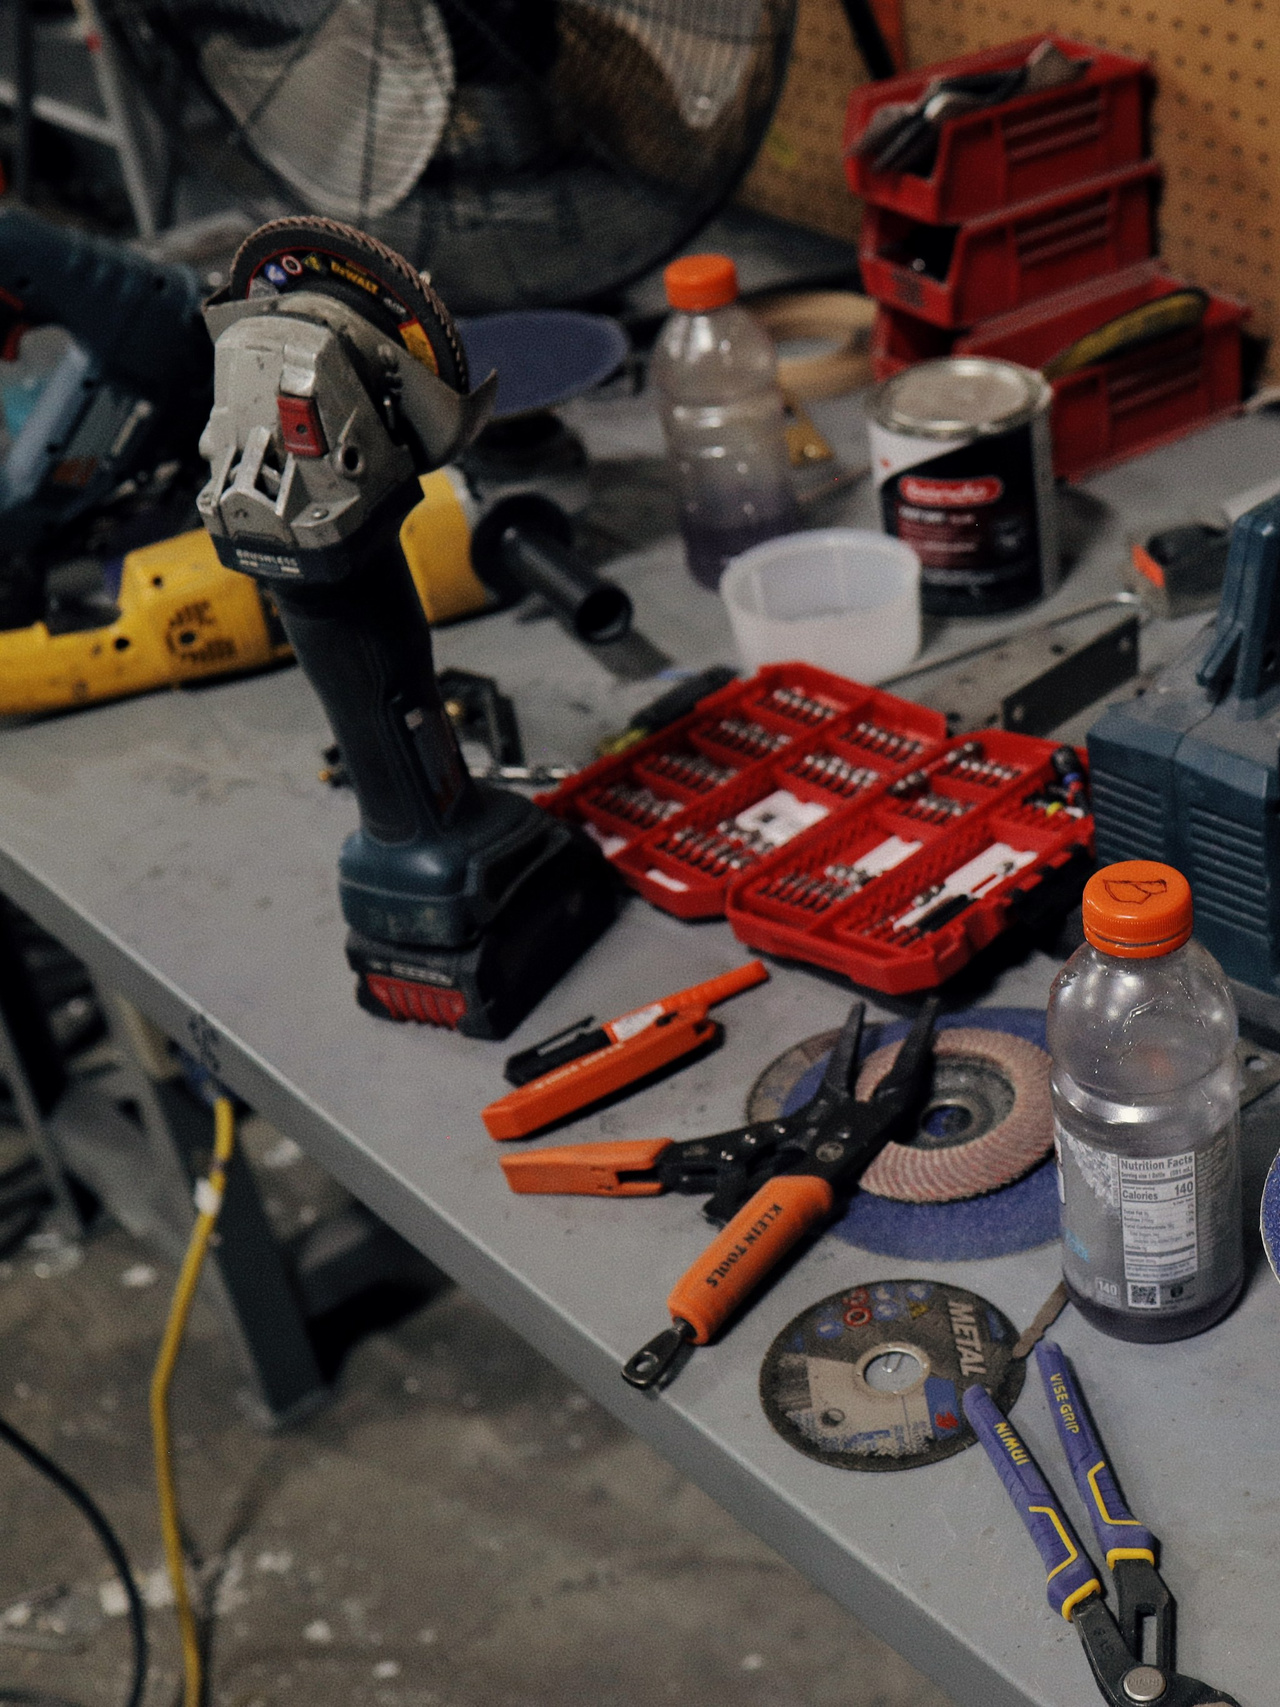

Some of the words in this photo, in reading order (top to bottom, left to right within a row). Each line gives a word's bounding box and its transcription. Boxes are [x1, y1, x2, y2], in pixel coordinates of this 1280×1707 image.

[1121, 1160, 1165, 1171] Nutrition
[1167, 1155, 1193, 1169] Facts
[1122, 1189, 1159, 1200] Calories
[1174, 1180, 1194, 1197] 140
[744, 1202, 784, 1245] KLEIN
[705, 1244, 748, 1287] TOOLS
[1098, 1281, 1117, 1296] 140
[947, 1300, 988, 1378] METAL
[1049, 1372, 1081, 1436] VISE-GRIP
[993, 1421, 1031, 1467] IRWIN
